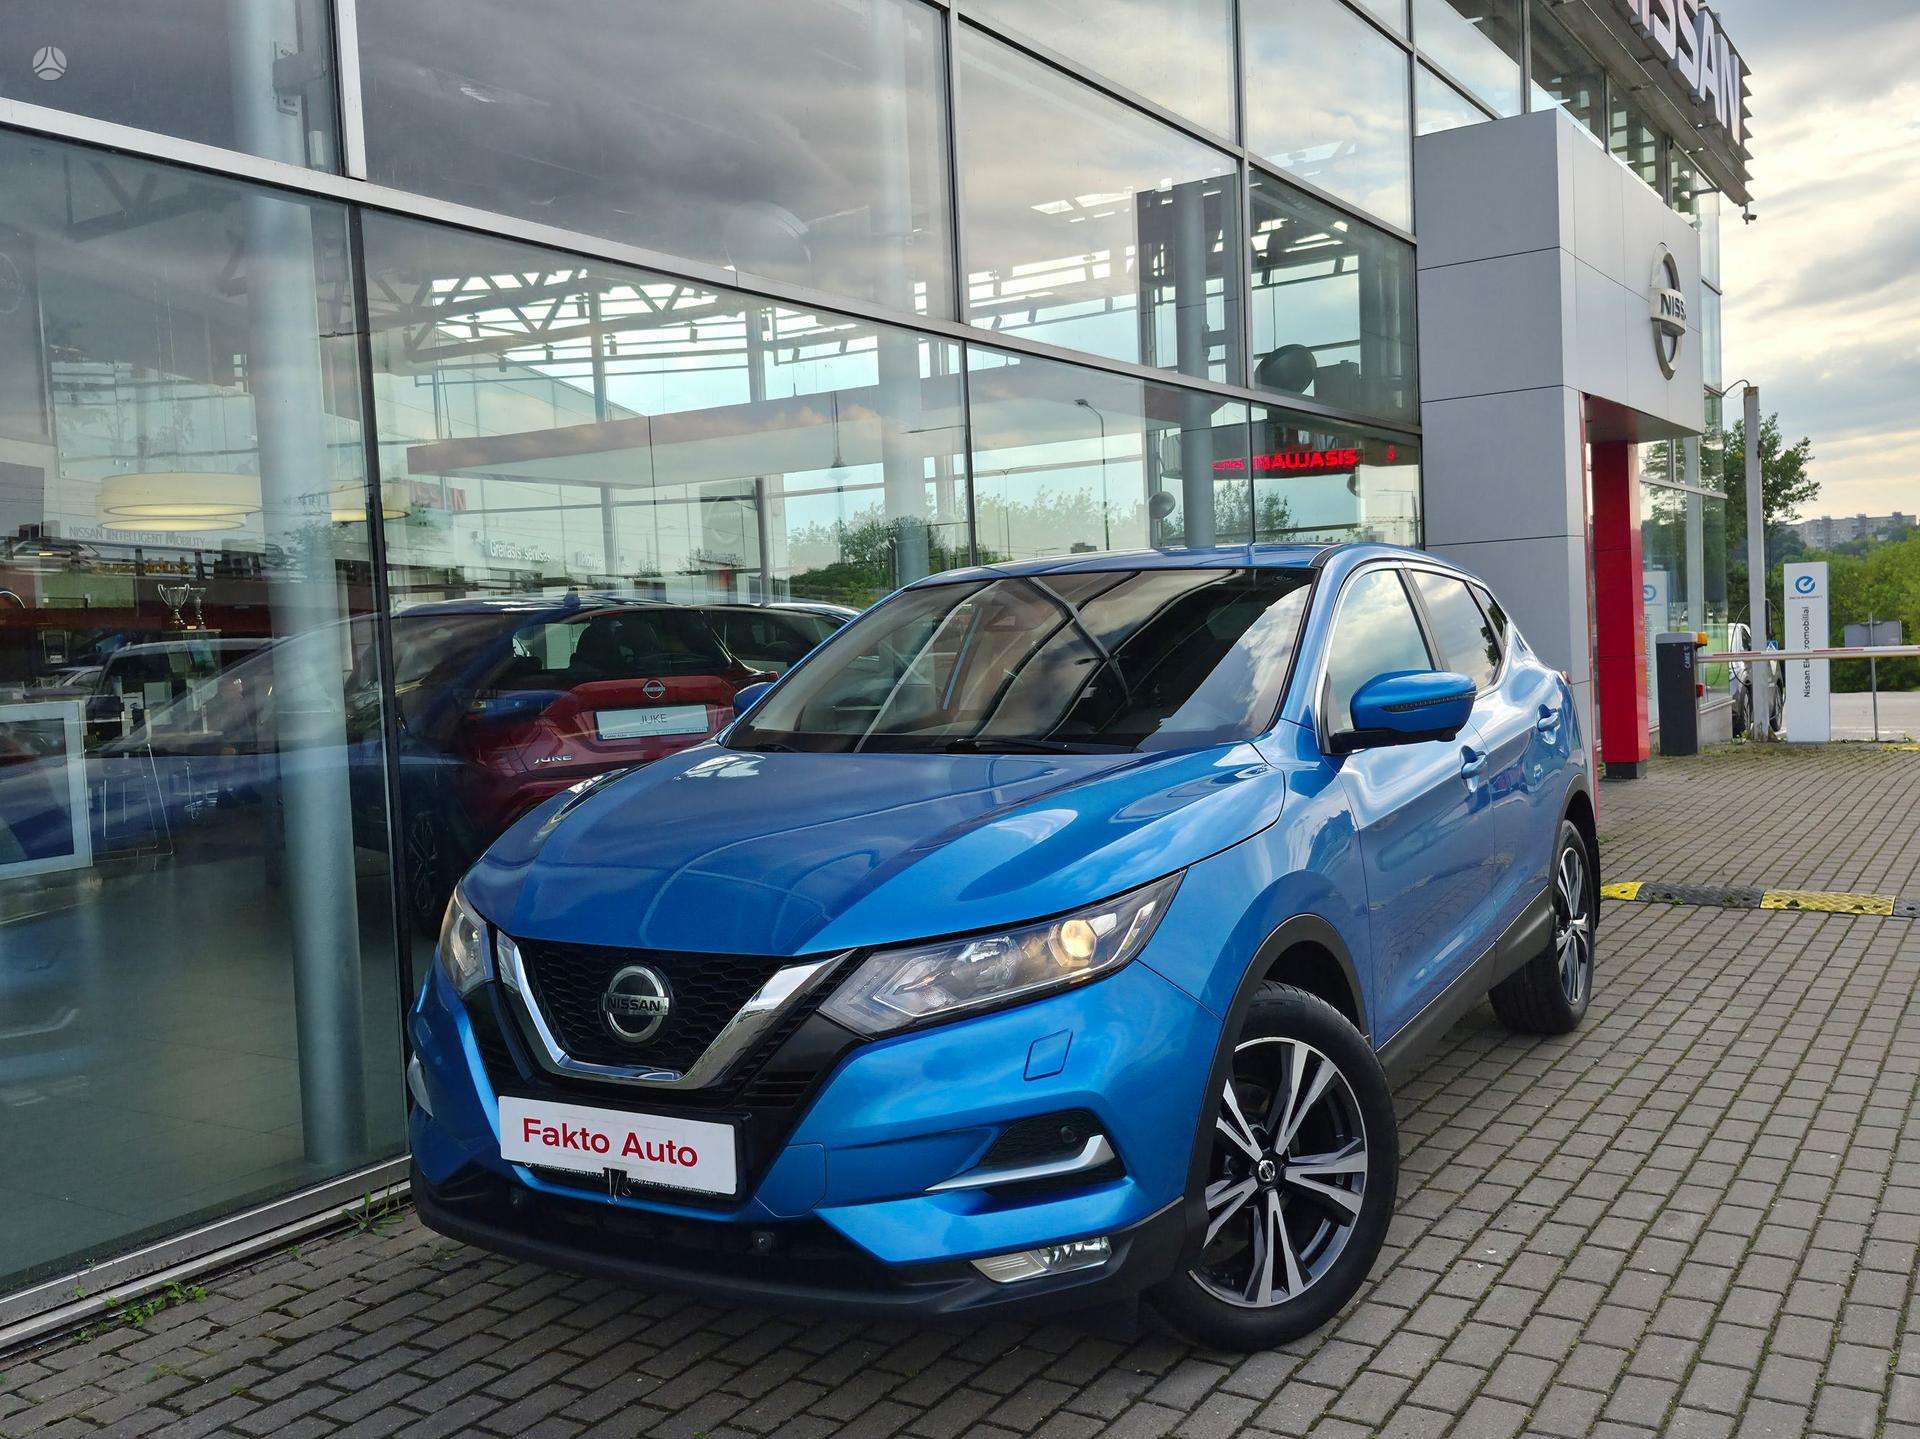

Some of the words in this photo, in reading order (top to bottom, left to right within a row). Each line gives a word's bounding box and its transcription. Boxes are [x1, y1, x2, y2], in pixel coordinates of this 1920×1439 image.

[1803, 670, 1811, 698] Nissan
[640, 713, 668, 725] JUKE
[534, 755, 572, 764] JUKE
[610, 998, 661, 1012] NISSAN
[522, 1117, 610, 1154] Fakto
[621, 1131, 698, 1168] Auto
